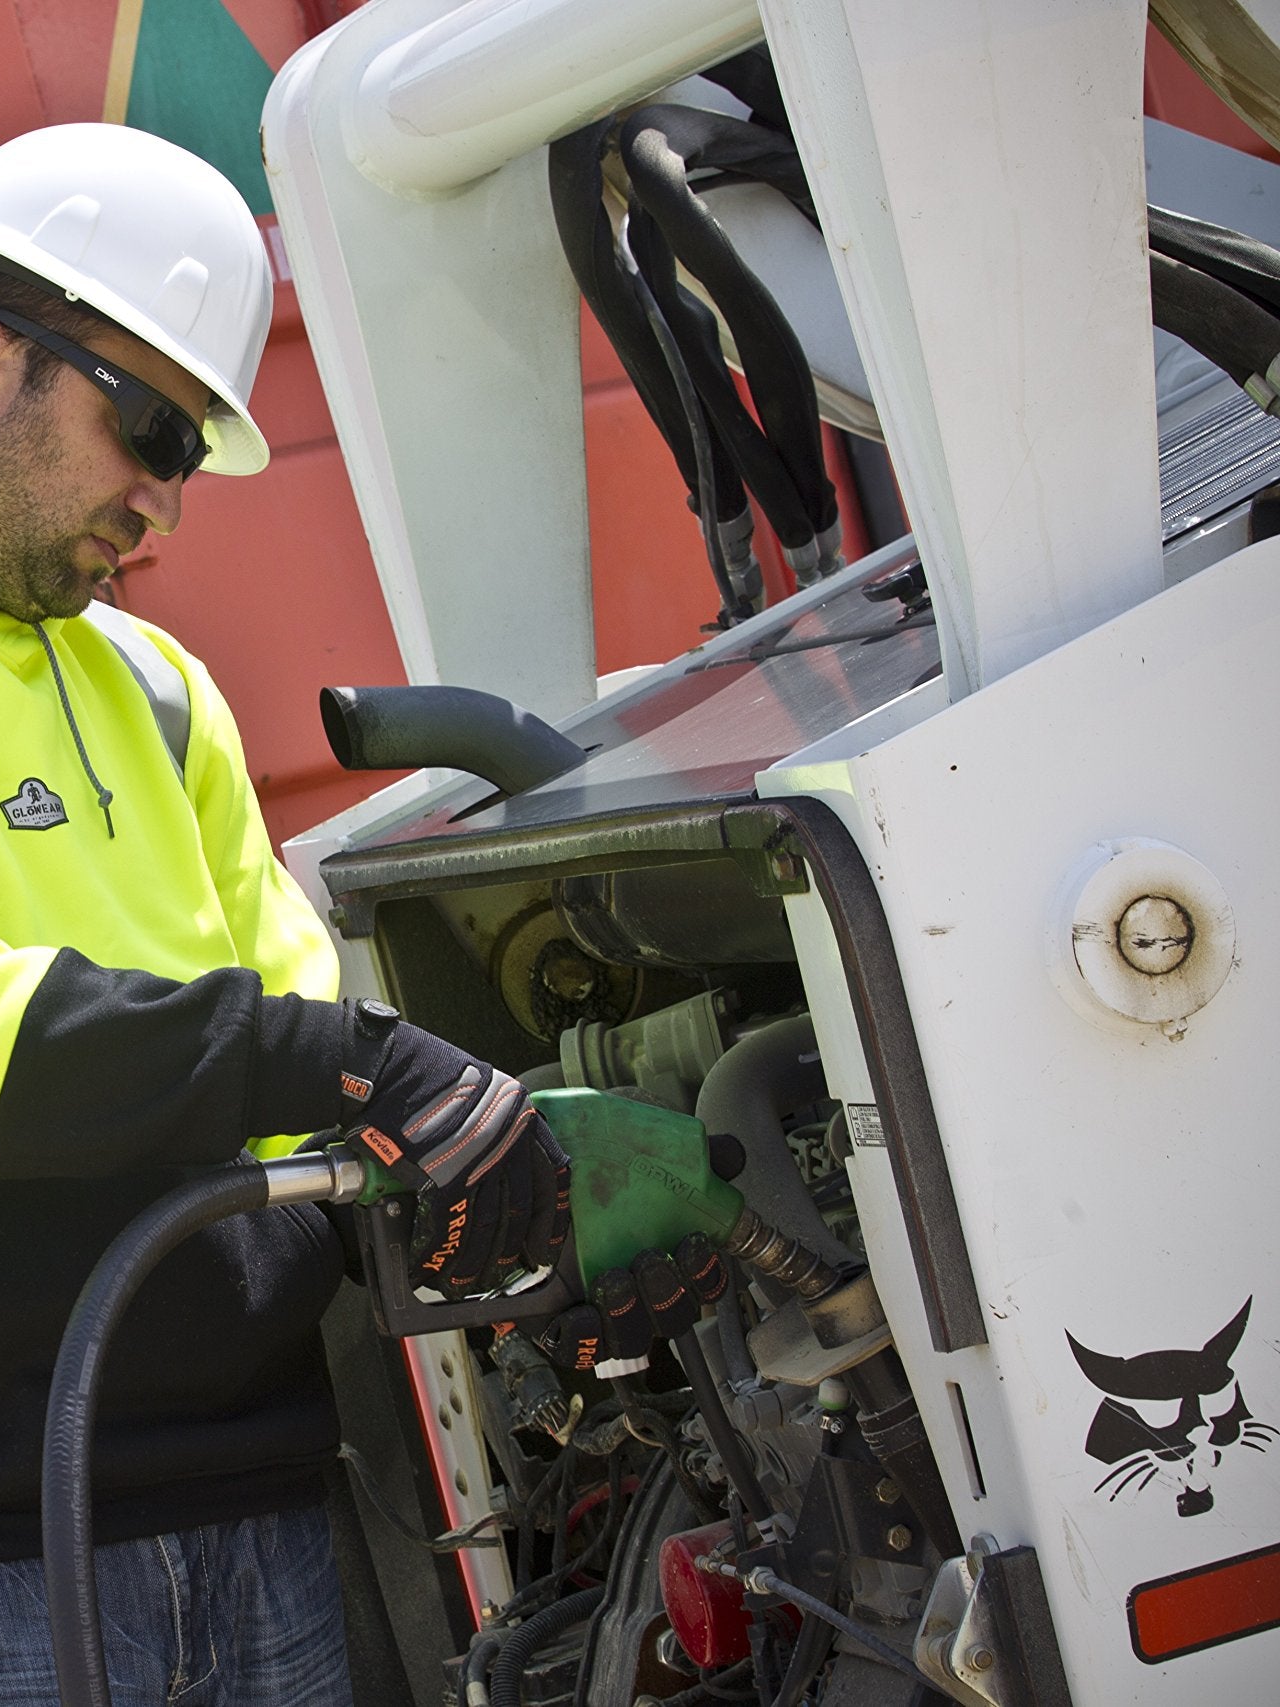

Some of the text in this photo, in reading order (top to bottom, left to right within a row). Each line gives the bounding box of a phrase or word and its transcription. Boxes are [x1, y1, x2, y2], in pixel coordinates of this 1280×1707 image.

[76, 1399, 87, 1416] USA
[74, 1557, 85, 1581] HOSE
[76, 1582, 90, 1626] GASOLINE
